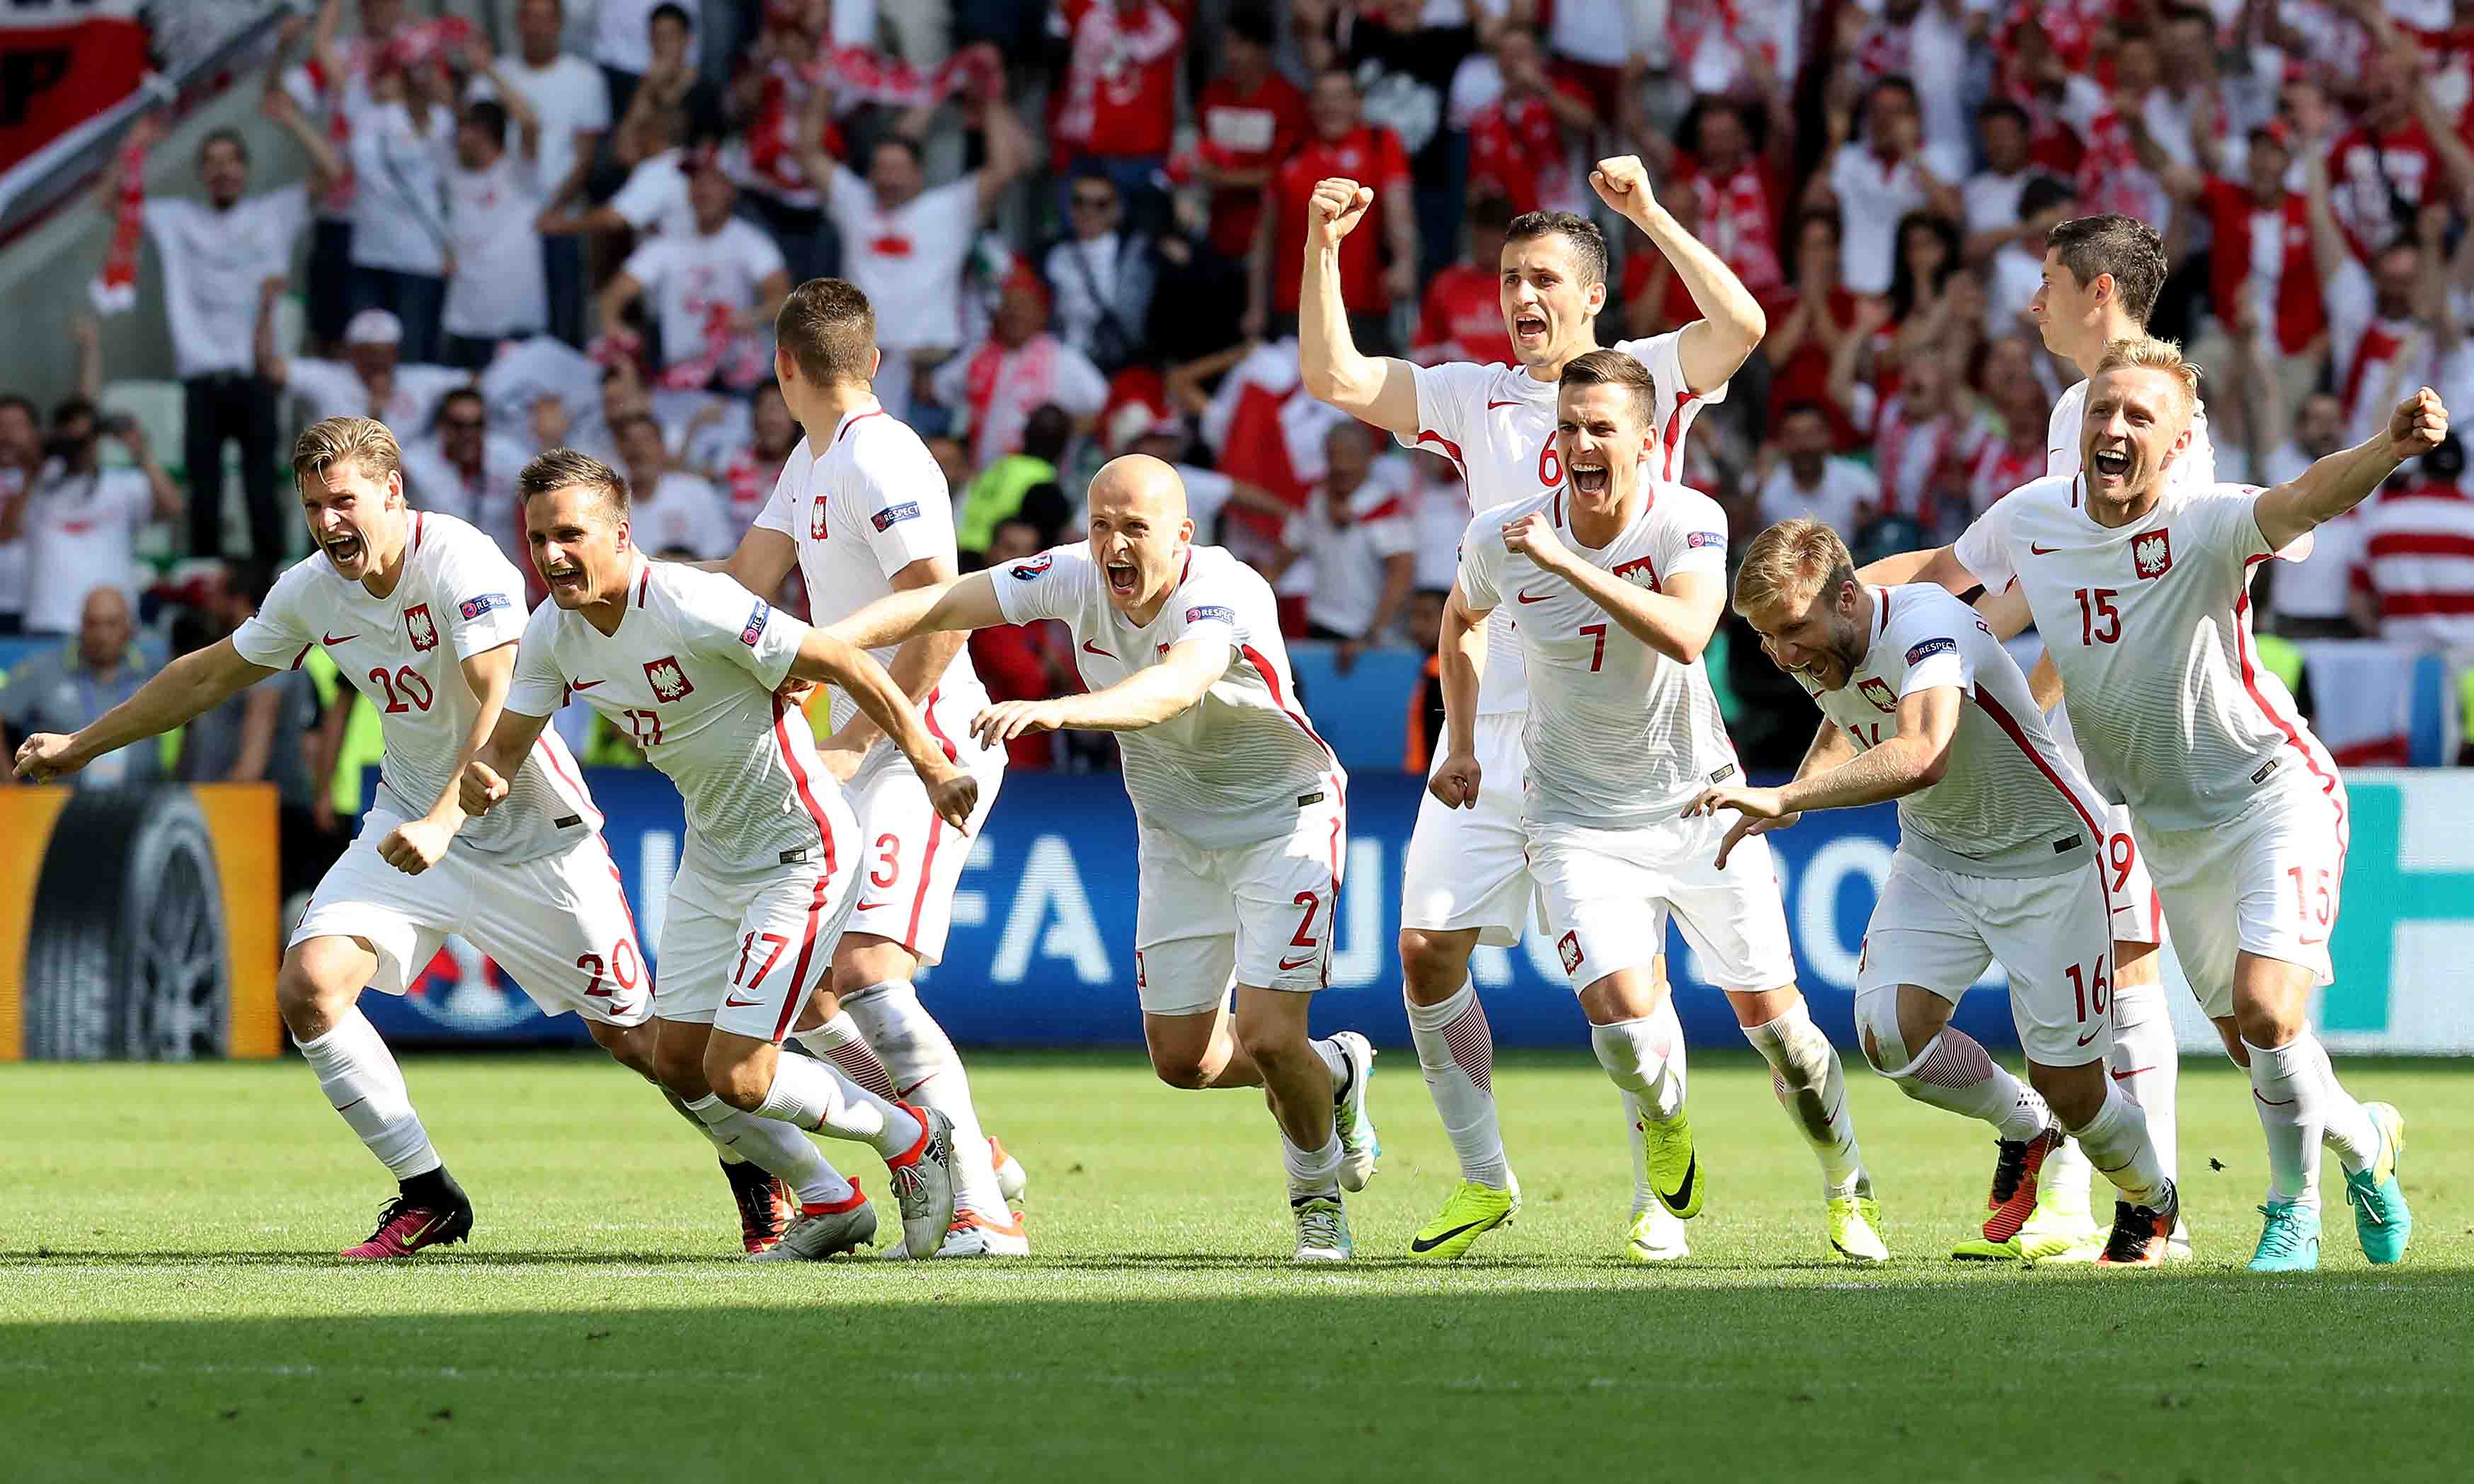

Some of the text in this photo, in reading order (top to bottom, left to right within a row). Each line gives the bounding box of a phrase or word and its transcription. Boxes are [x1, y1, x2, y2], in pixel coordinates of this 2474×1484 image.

[1538, 430, 1564, 488] 6
[883, 505, 919, 522] RESPECT
[2075, 587, 2122, 647] 15
[1579, 623, 1607, 673] 7
[1919, 642, 1957, 655] RESPECT
[368, 665, 433, 714] 20
[870, 832, 901, 890] 3
[2109, 832, 2136, 894] 9
[1289, 890, 1321, 948] 2
[2287, 865, 2330, 927] 15
[575, 938, 638, 998] 20
[732, 931, 791, 992] 17
[2065, 953, 2108, 1023] 16
